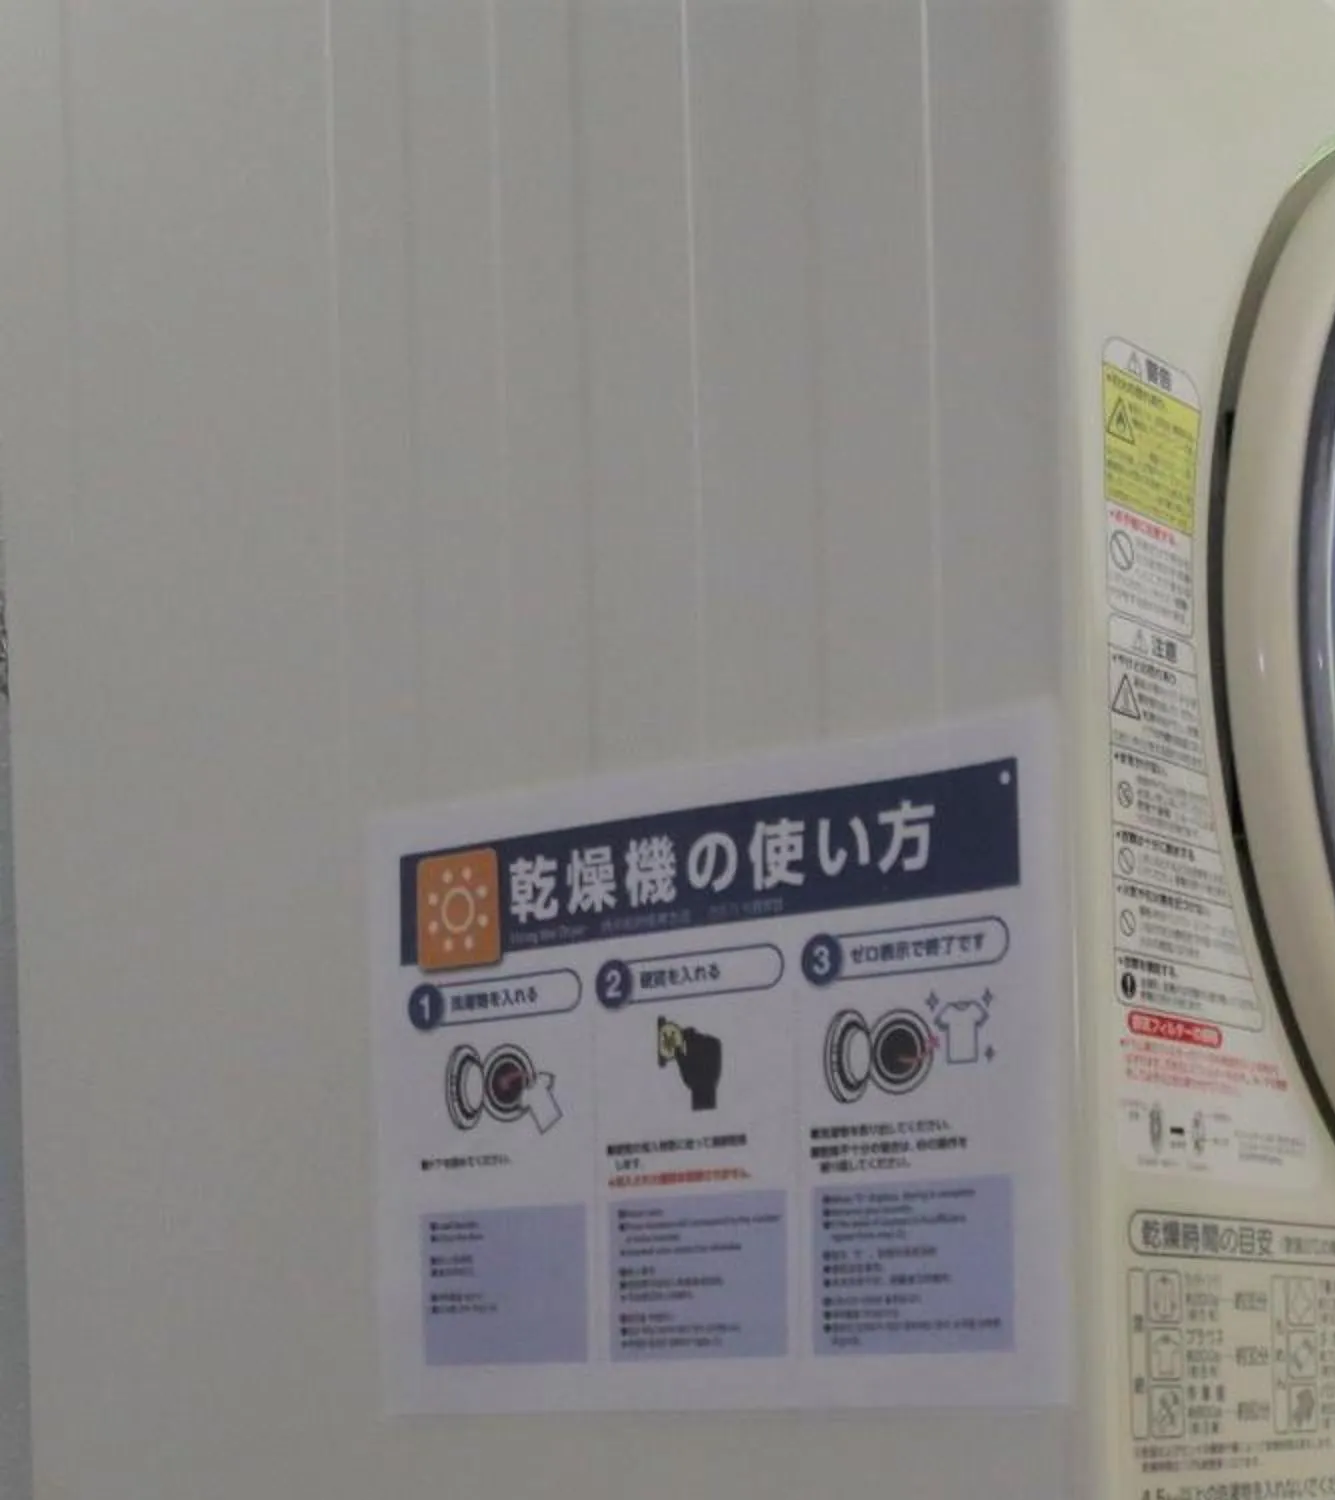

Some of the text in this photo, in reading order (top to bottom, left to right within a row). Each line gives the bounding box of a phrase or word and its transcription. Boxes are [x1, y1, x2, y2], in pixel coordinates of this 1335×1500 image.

[509, 799, 936, 923] 乾燥機の使い方
